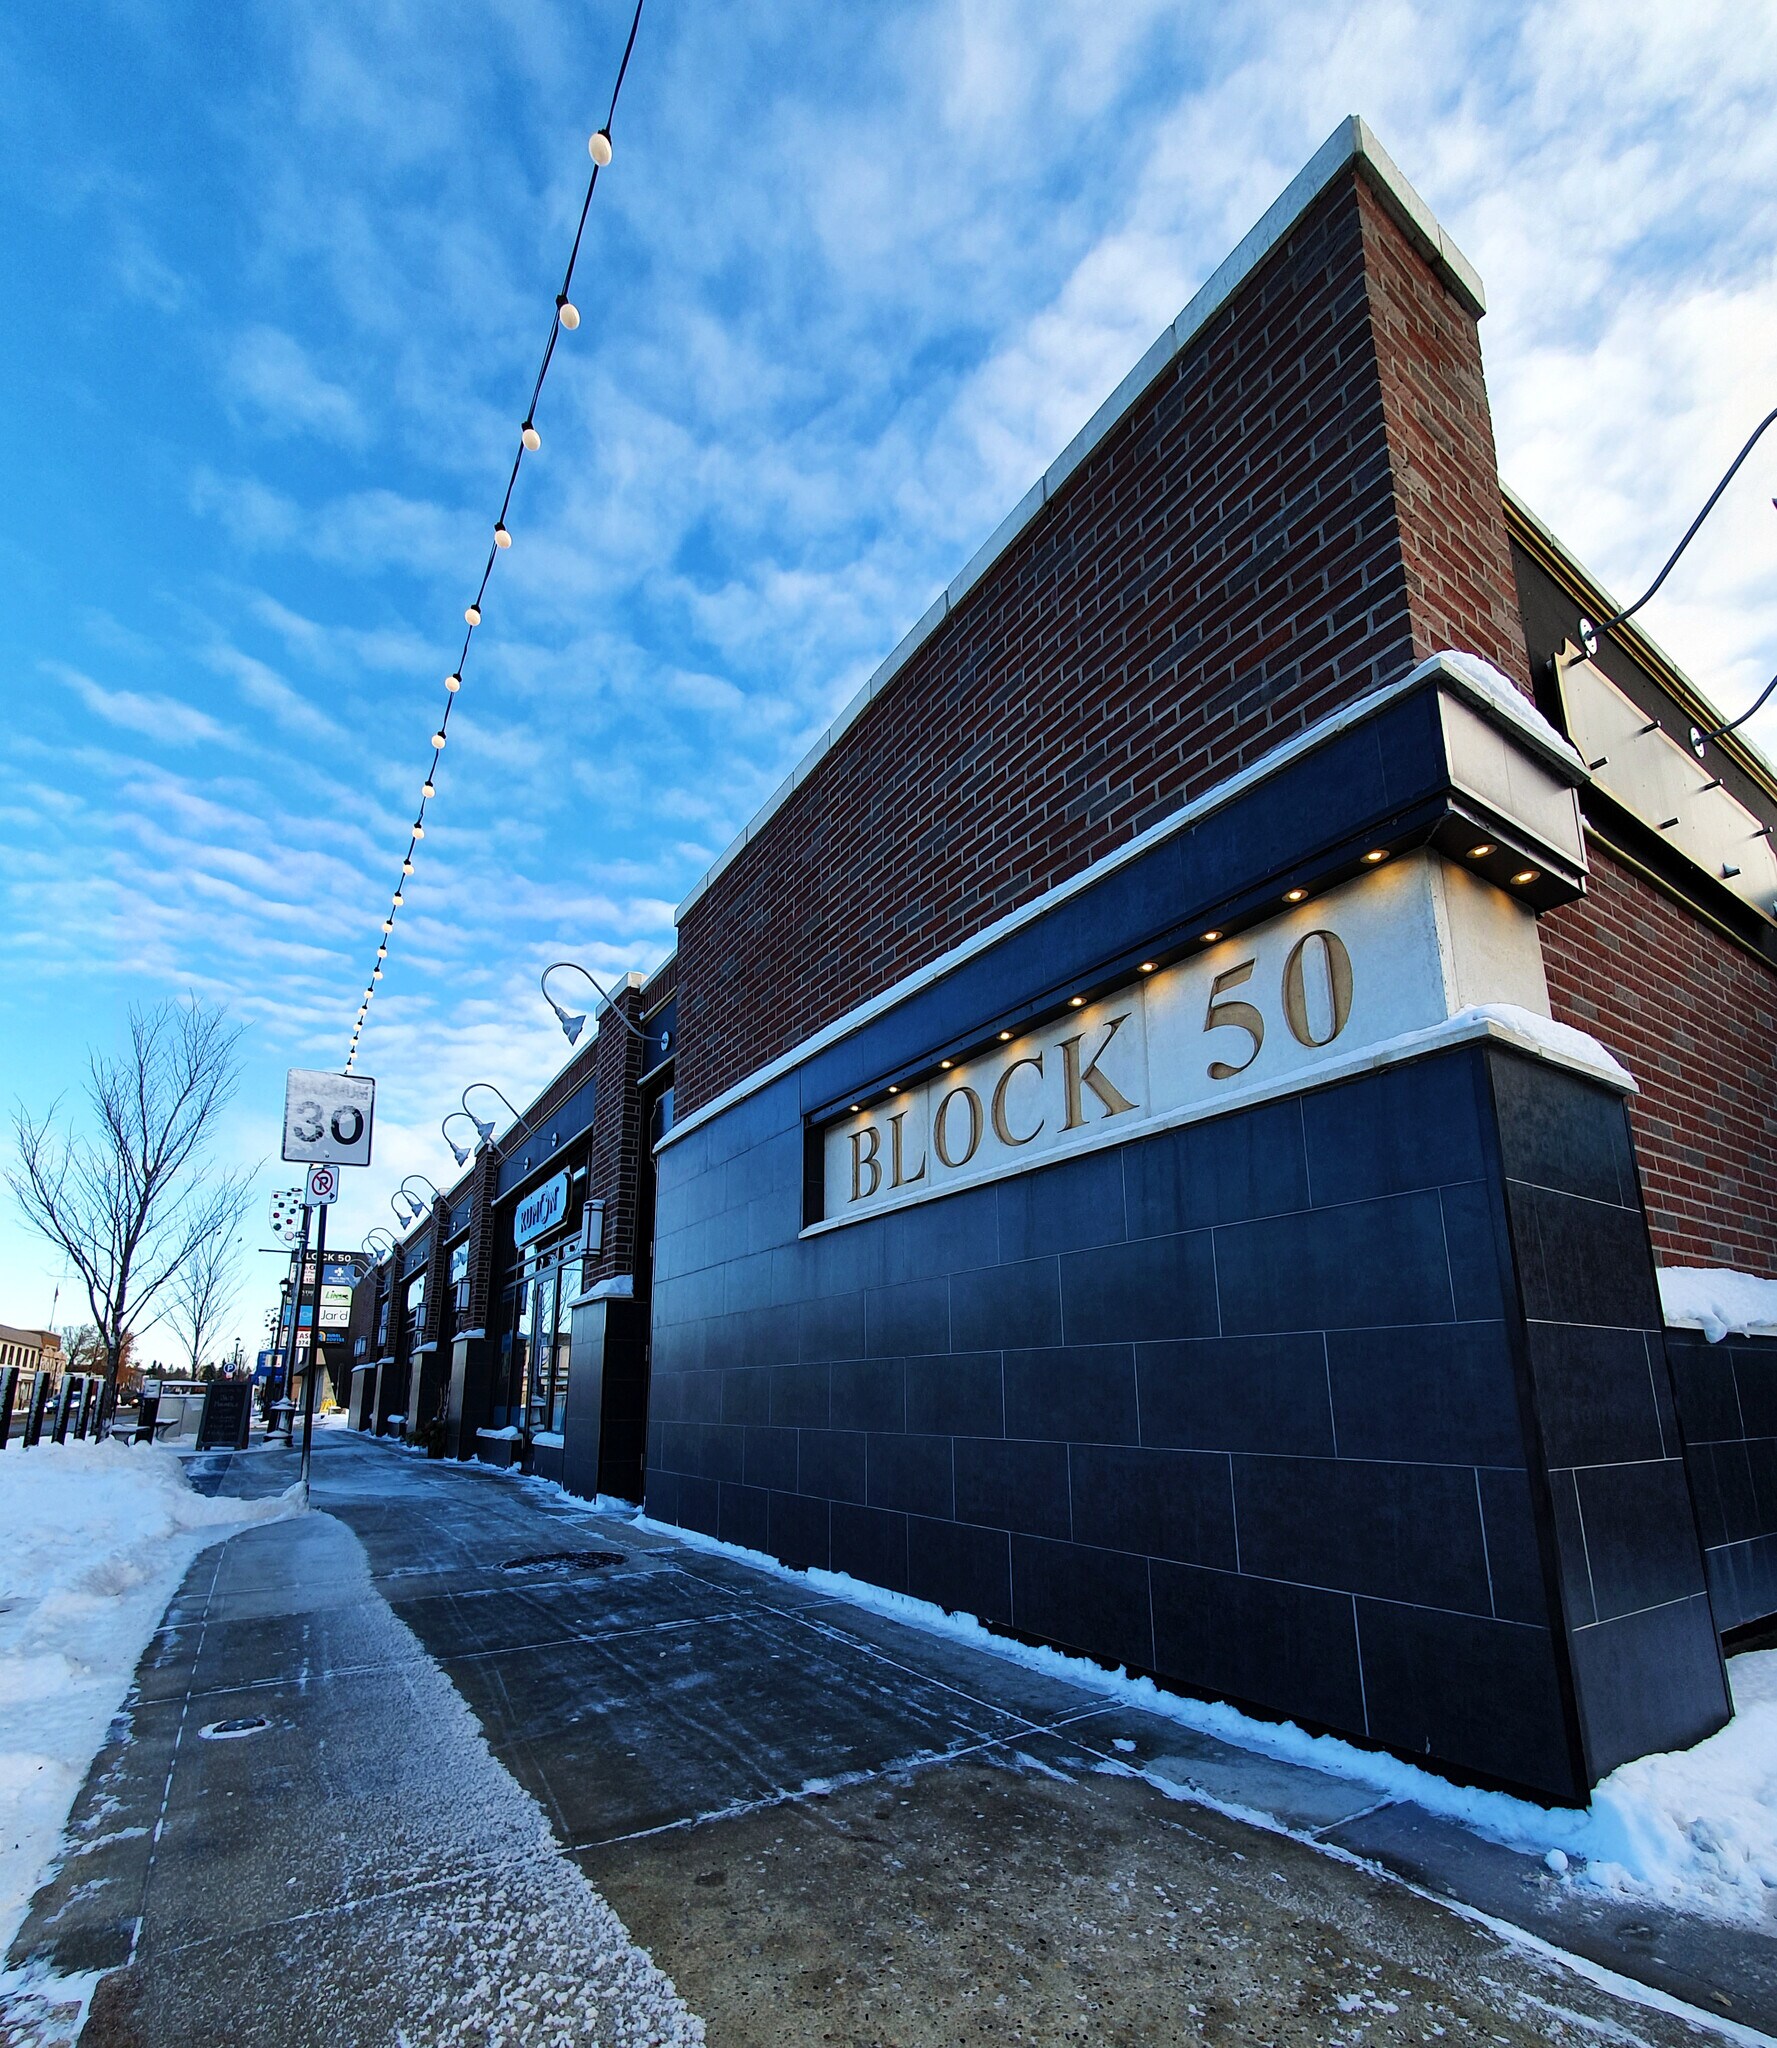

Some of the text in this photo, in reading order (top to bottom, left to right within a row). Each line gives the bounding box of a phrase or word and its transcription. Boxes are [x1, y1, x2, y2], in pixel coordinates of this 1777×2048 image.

[847, 929, 1353, 1203] BLOCK 50
[293, 1101, 364, 1145] 30
[520, 1186, 560, 1234] KUMON
[305, 1252, 352, 1262] LOCK 50
